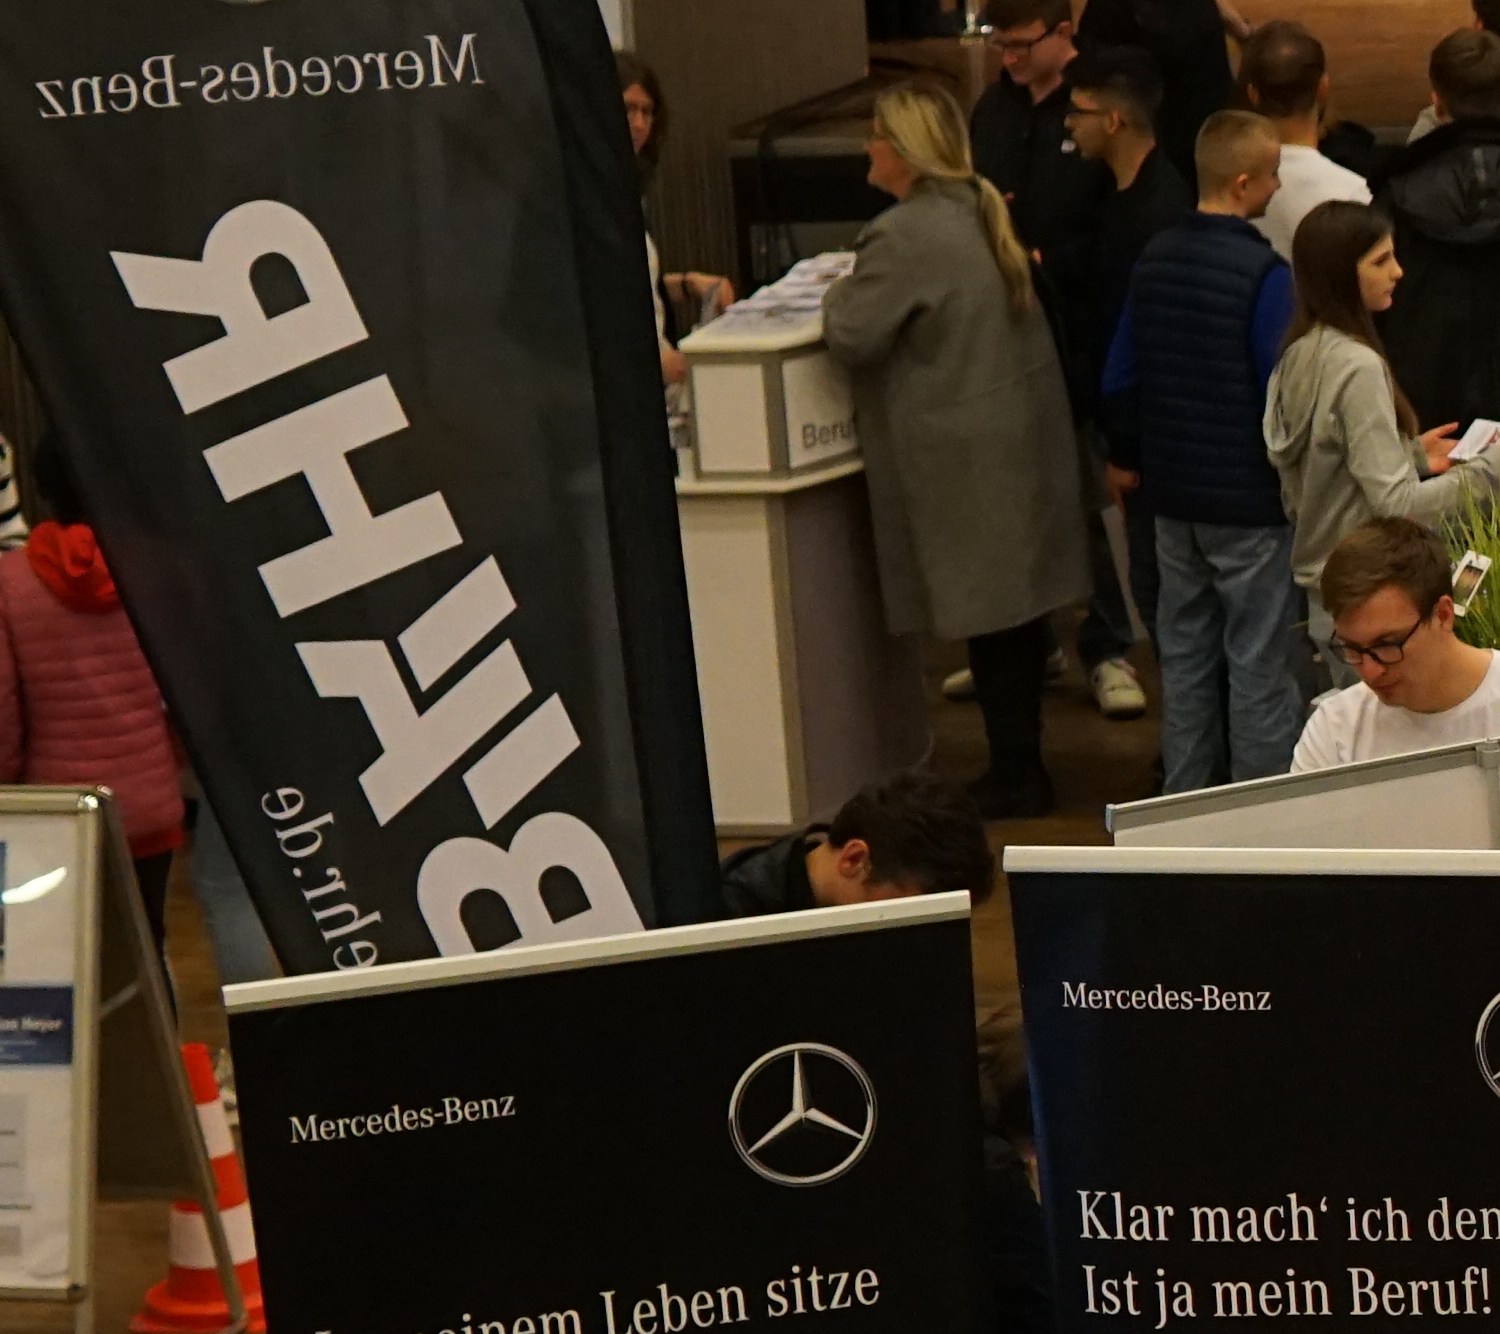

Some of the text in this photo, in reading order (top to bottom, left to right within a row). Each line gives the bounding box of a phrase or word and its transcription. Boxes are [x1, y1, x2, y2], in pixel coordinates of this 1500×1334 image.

[1062, 981, 1272, 1011] Mercedes-Benz
[289, 1095, 516, 1144] Mercedes-Benz
[1076, 1189, 1175, 1242] Klar
[1345, 1196, 1412, 1242] ich
[766, 1265, 880, 1318] sitze
[1082, 1264, 1492, 1330] Ist ja mein Beruf!
